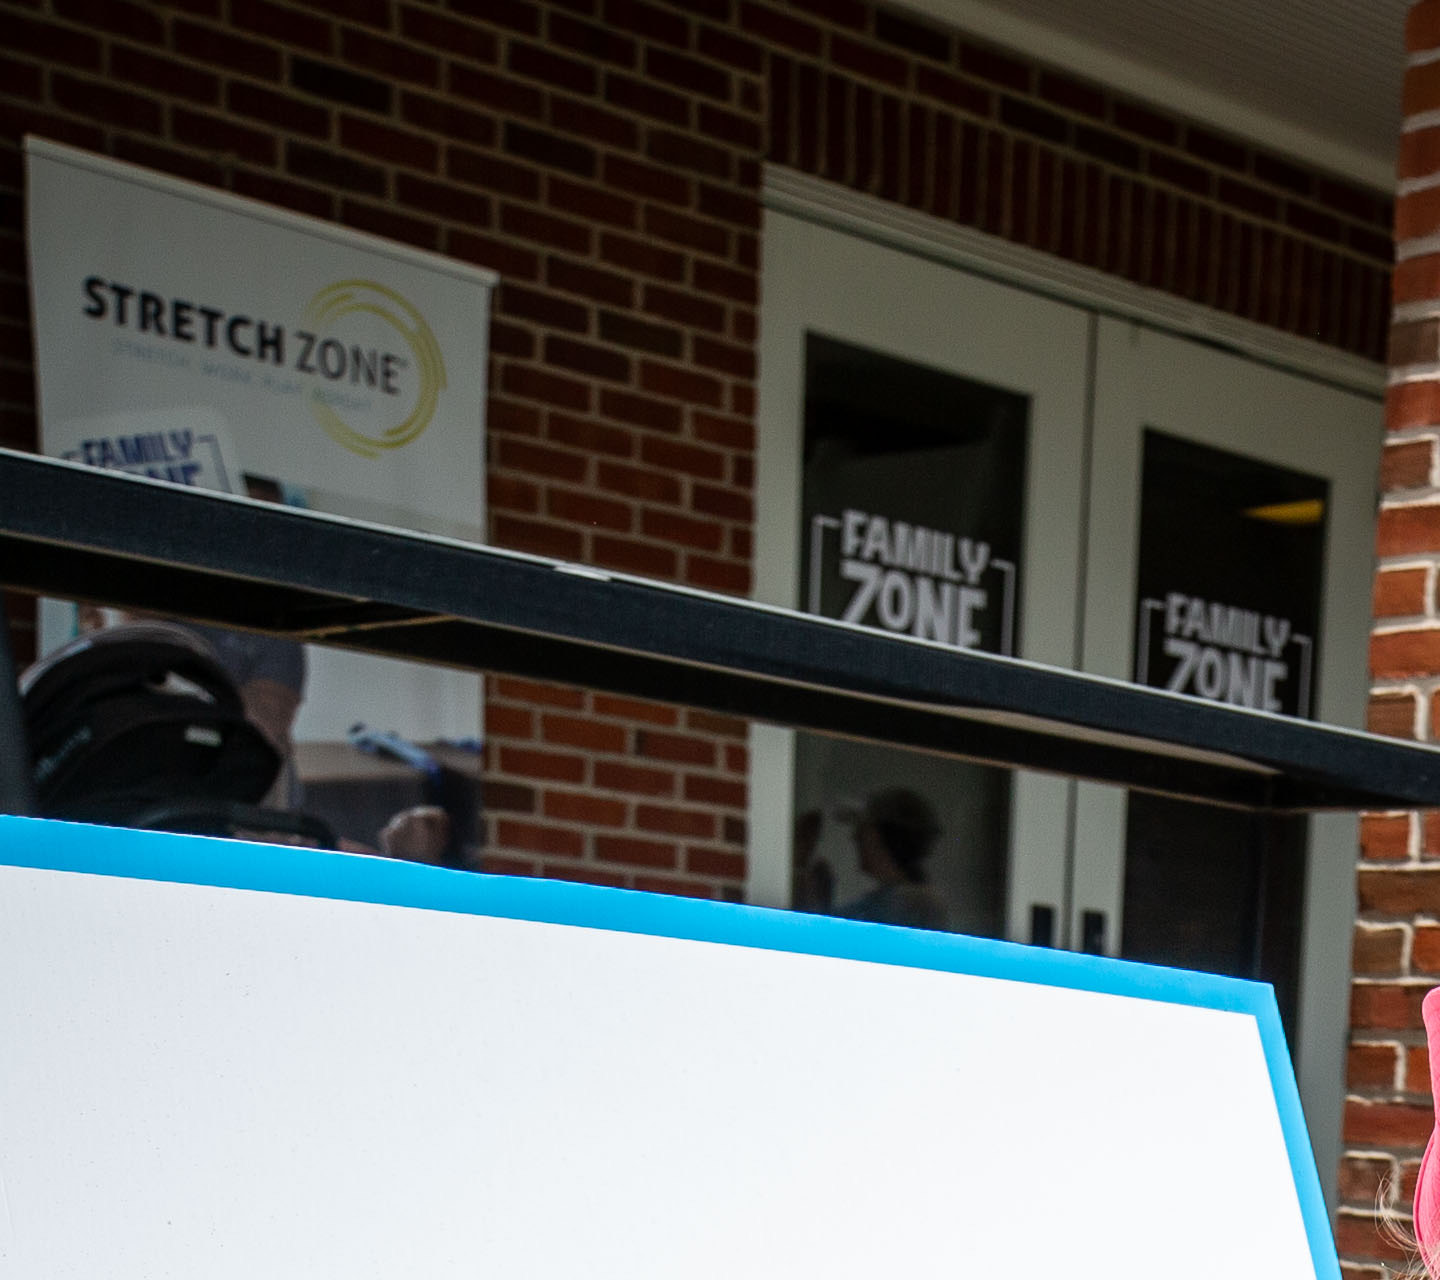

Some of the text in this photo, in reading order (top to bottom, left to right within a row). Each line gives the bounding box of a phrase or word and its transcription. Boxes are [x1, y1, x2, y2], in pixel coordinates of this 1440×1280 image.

[83, 276, 284, 365] STRETCH
[294, 331, 403, 395] ZONE
[81, 429, 194, 467] FAMILY
[839, 508, 991, 586] FAMILY
[839, 557, 988, 648] ZONE
[1163, 590, 1292, 658] FAMILY
[1162, 637, 1289, 713] ZONE
